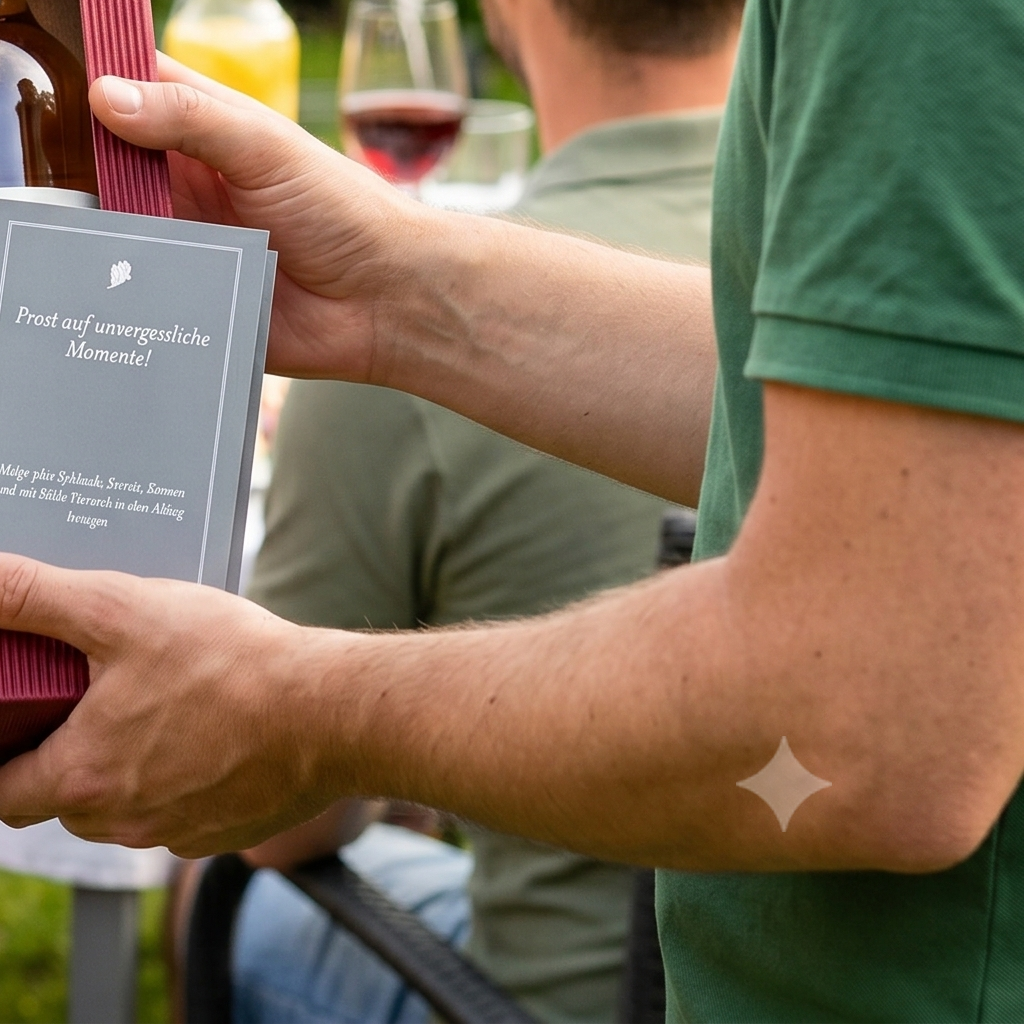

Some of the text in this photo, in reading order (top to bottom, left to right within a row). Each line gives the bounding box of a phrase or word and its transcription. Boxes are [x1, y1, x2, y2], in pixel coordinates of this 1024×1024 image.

[15, 305, 211, 347] Prost auf unvergessliche
[64, 339, 153, 367] Momente!
[19, 487, 37, 499] mit
[114, 497, 125, 510] in
